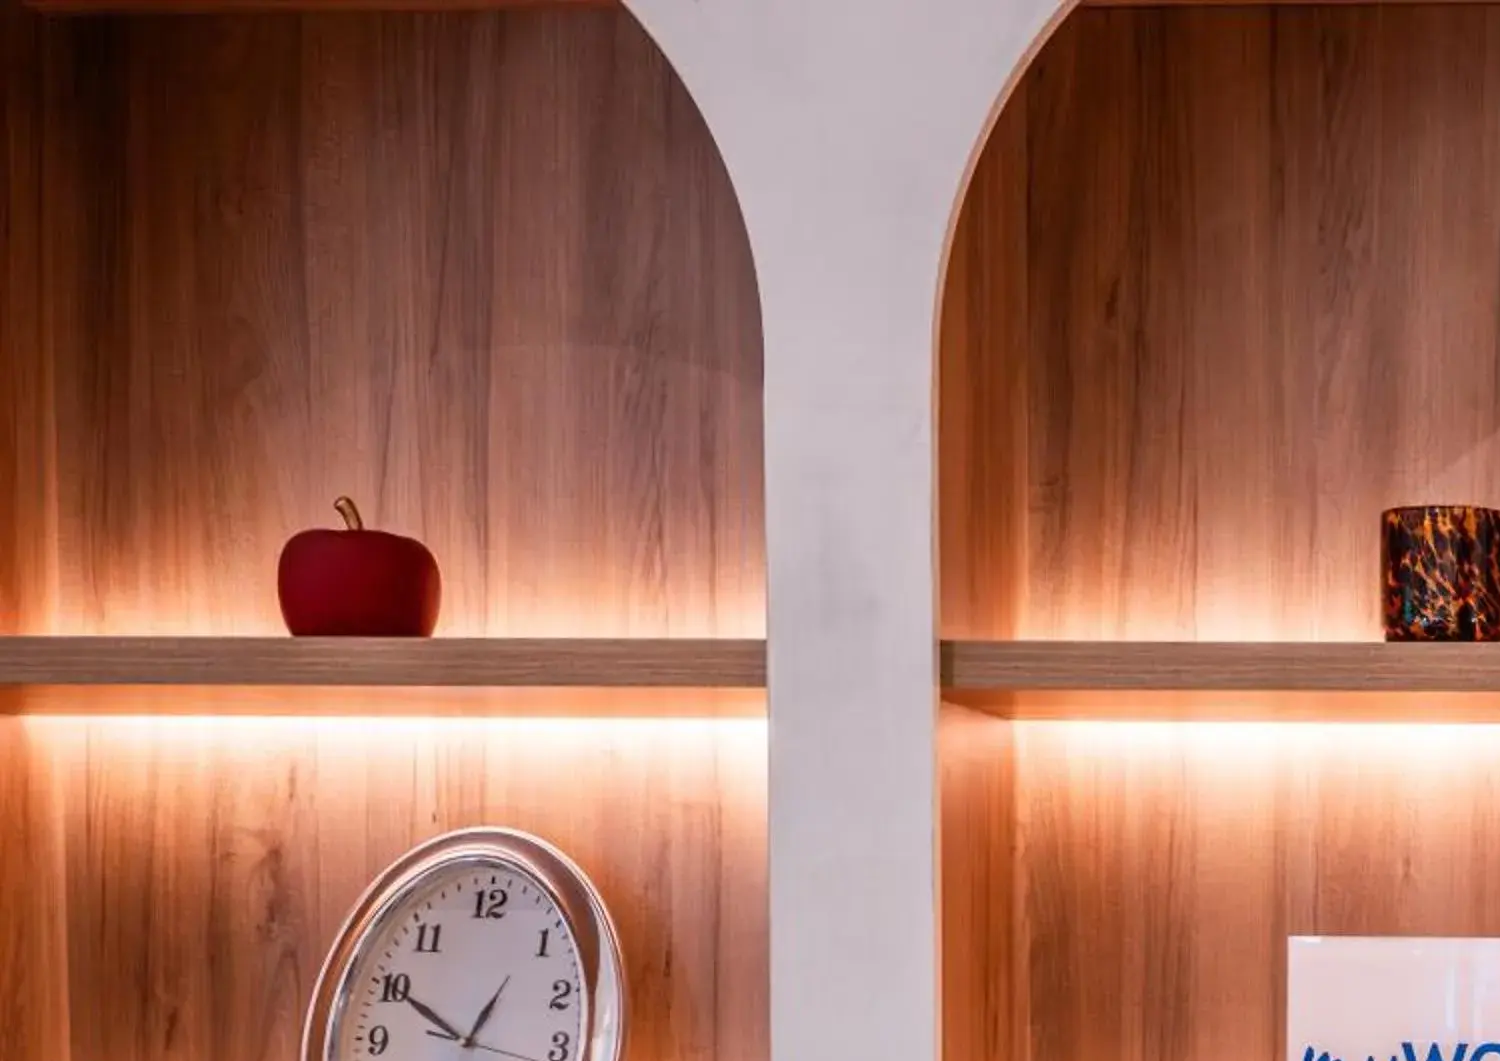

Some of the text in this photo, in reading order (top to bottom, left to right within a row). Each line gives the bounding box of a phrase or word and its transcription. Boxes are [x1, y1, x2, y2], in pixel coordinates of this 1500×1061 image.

[472, 889, 508, 919] 12
[414, 924, 442, 953] 11
[535, 928, 550, 957] 1
[379, 973, 411, 1002] 10
[550, 981, 571, 1010] 2
[368, 1026, 389, 1056] 9
